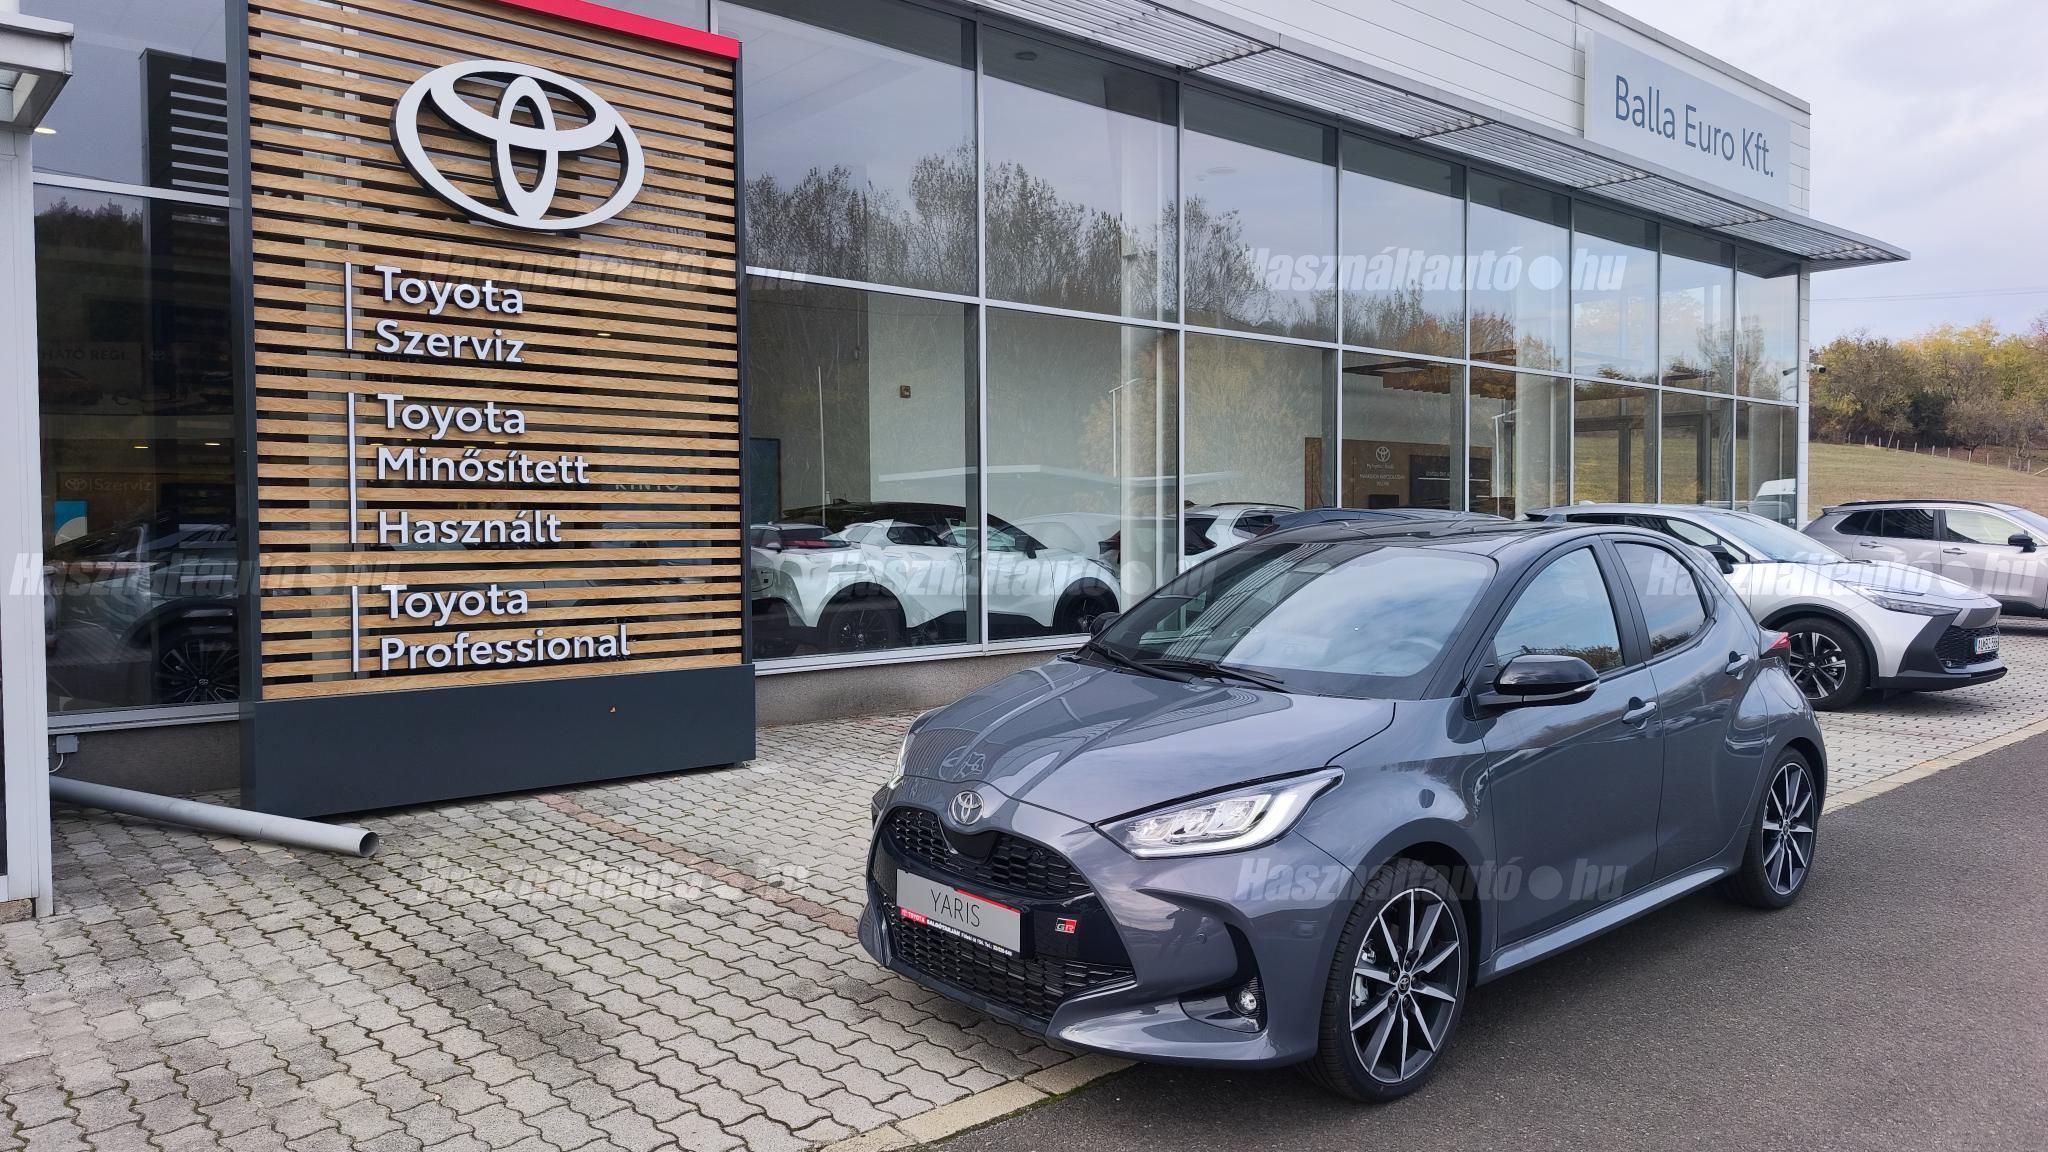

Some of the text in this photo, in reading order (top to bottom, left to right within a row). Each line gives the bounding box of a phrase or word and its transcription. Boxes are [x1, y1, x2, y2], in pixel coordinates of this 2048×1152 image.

[1615, 74, 1774, 178] Balla Euro Kft.
[375, 265, 523, 315] Toyota
[376, 319, 524, 363] Szerviz
[376, 393, 525, 440] Toyota
[377, 447, 590, 484] Minősített
[378, 510, 562, 544] Használt
[381, 583, 529, 627] Toyota
[380, 624, 631, 671] Professional
[930, 888, 981, 928] YARIS
